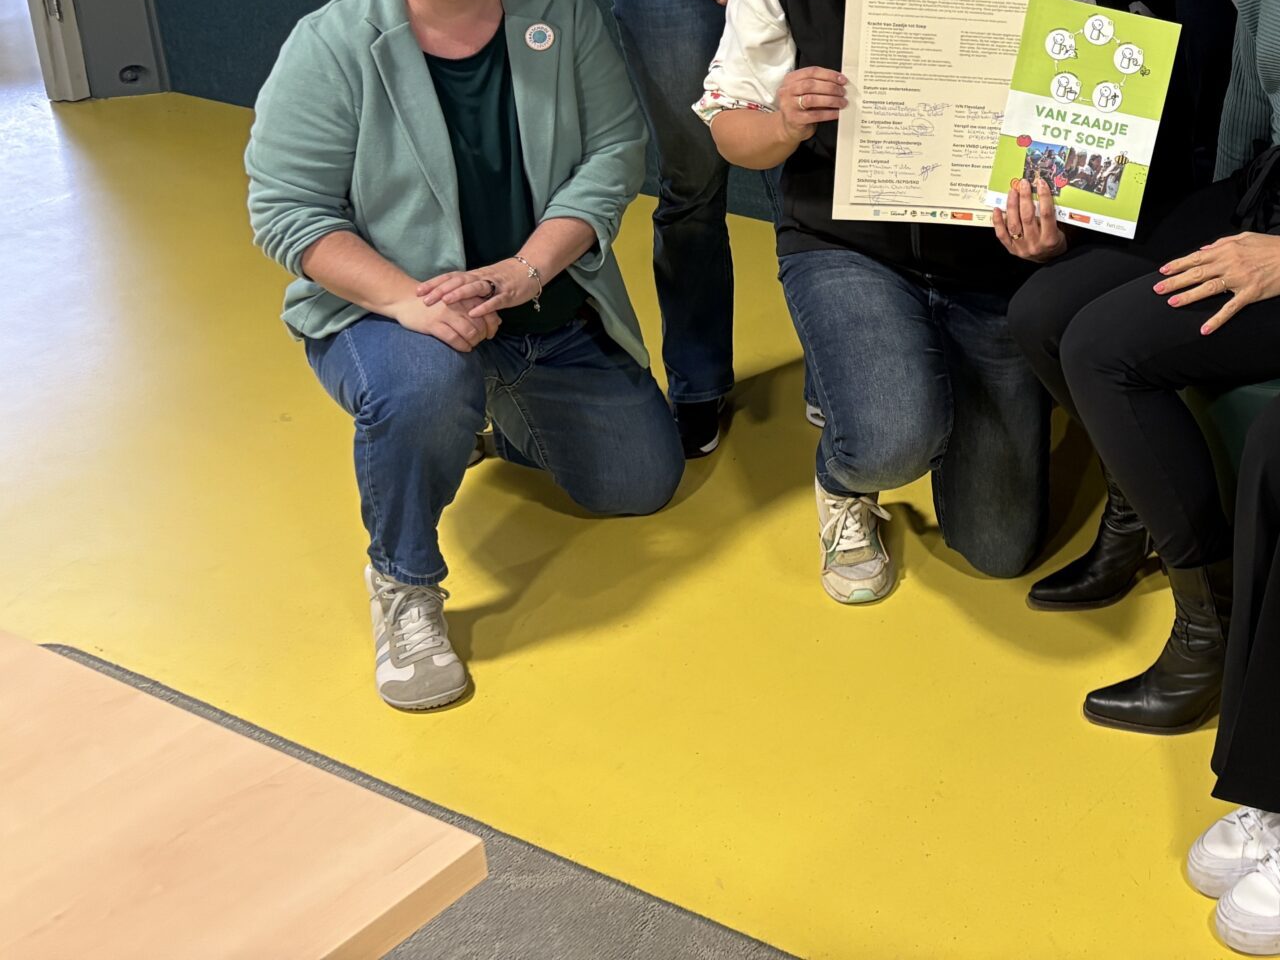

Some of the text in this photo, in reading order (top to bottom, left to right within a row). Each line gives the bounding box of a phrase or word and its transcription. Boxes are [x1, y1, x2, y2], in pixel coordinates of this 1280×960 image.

[1035, 104, 1129, 136] VAN ZAADJE
[1041, 124, 1115, 150] TOT SOEP
